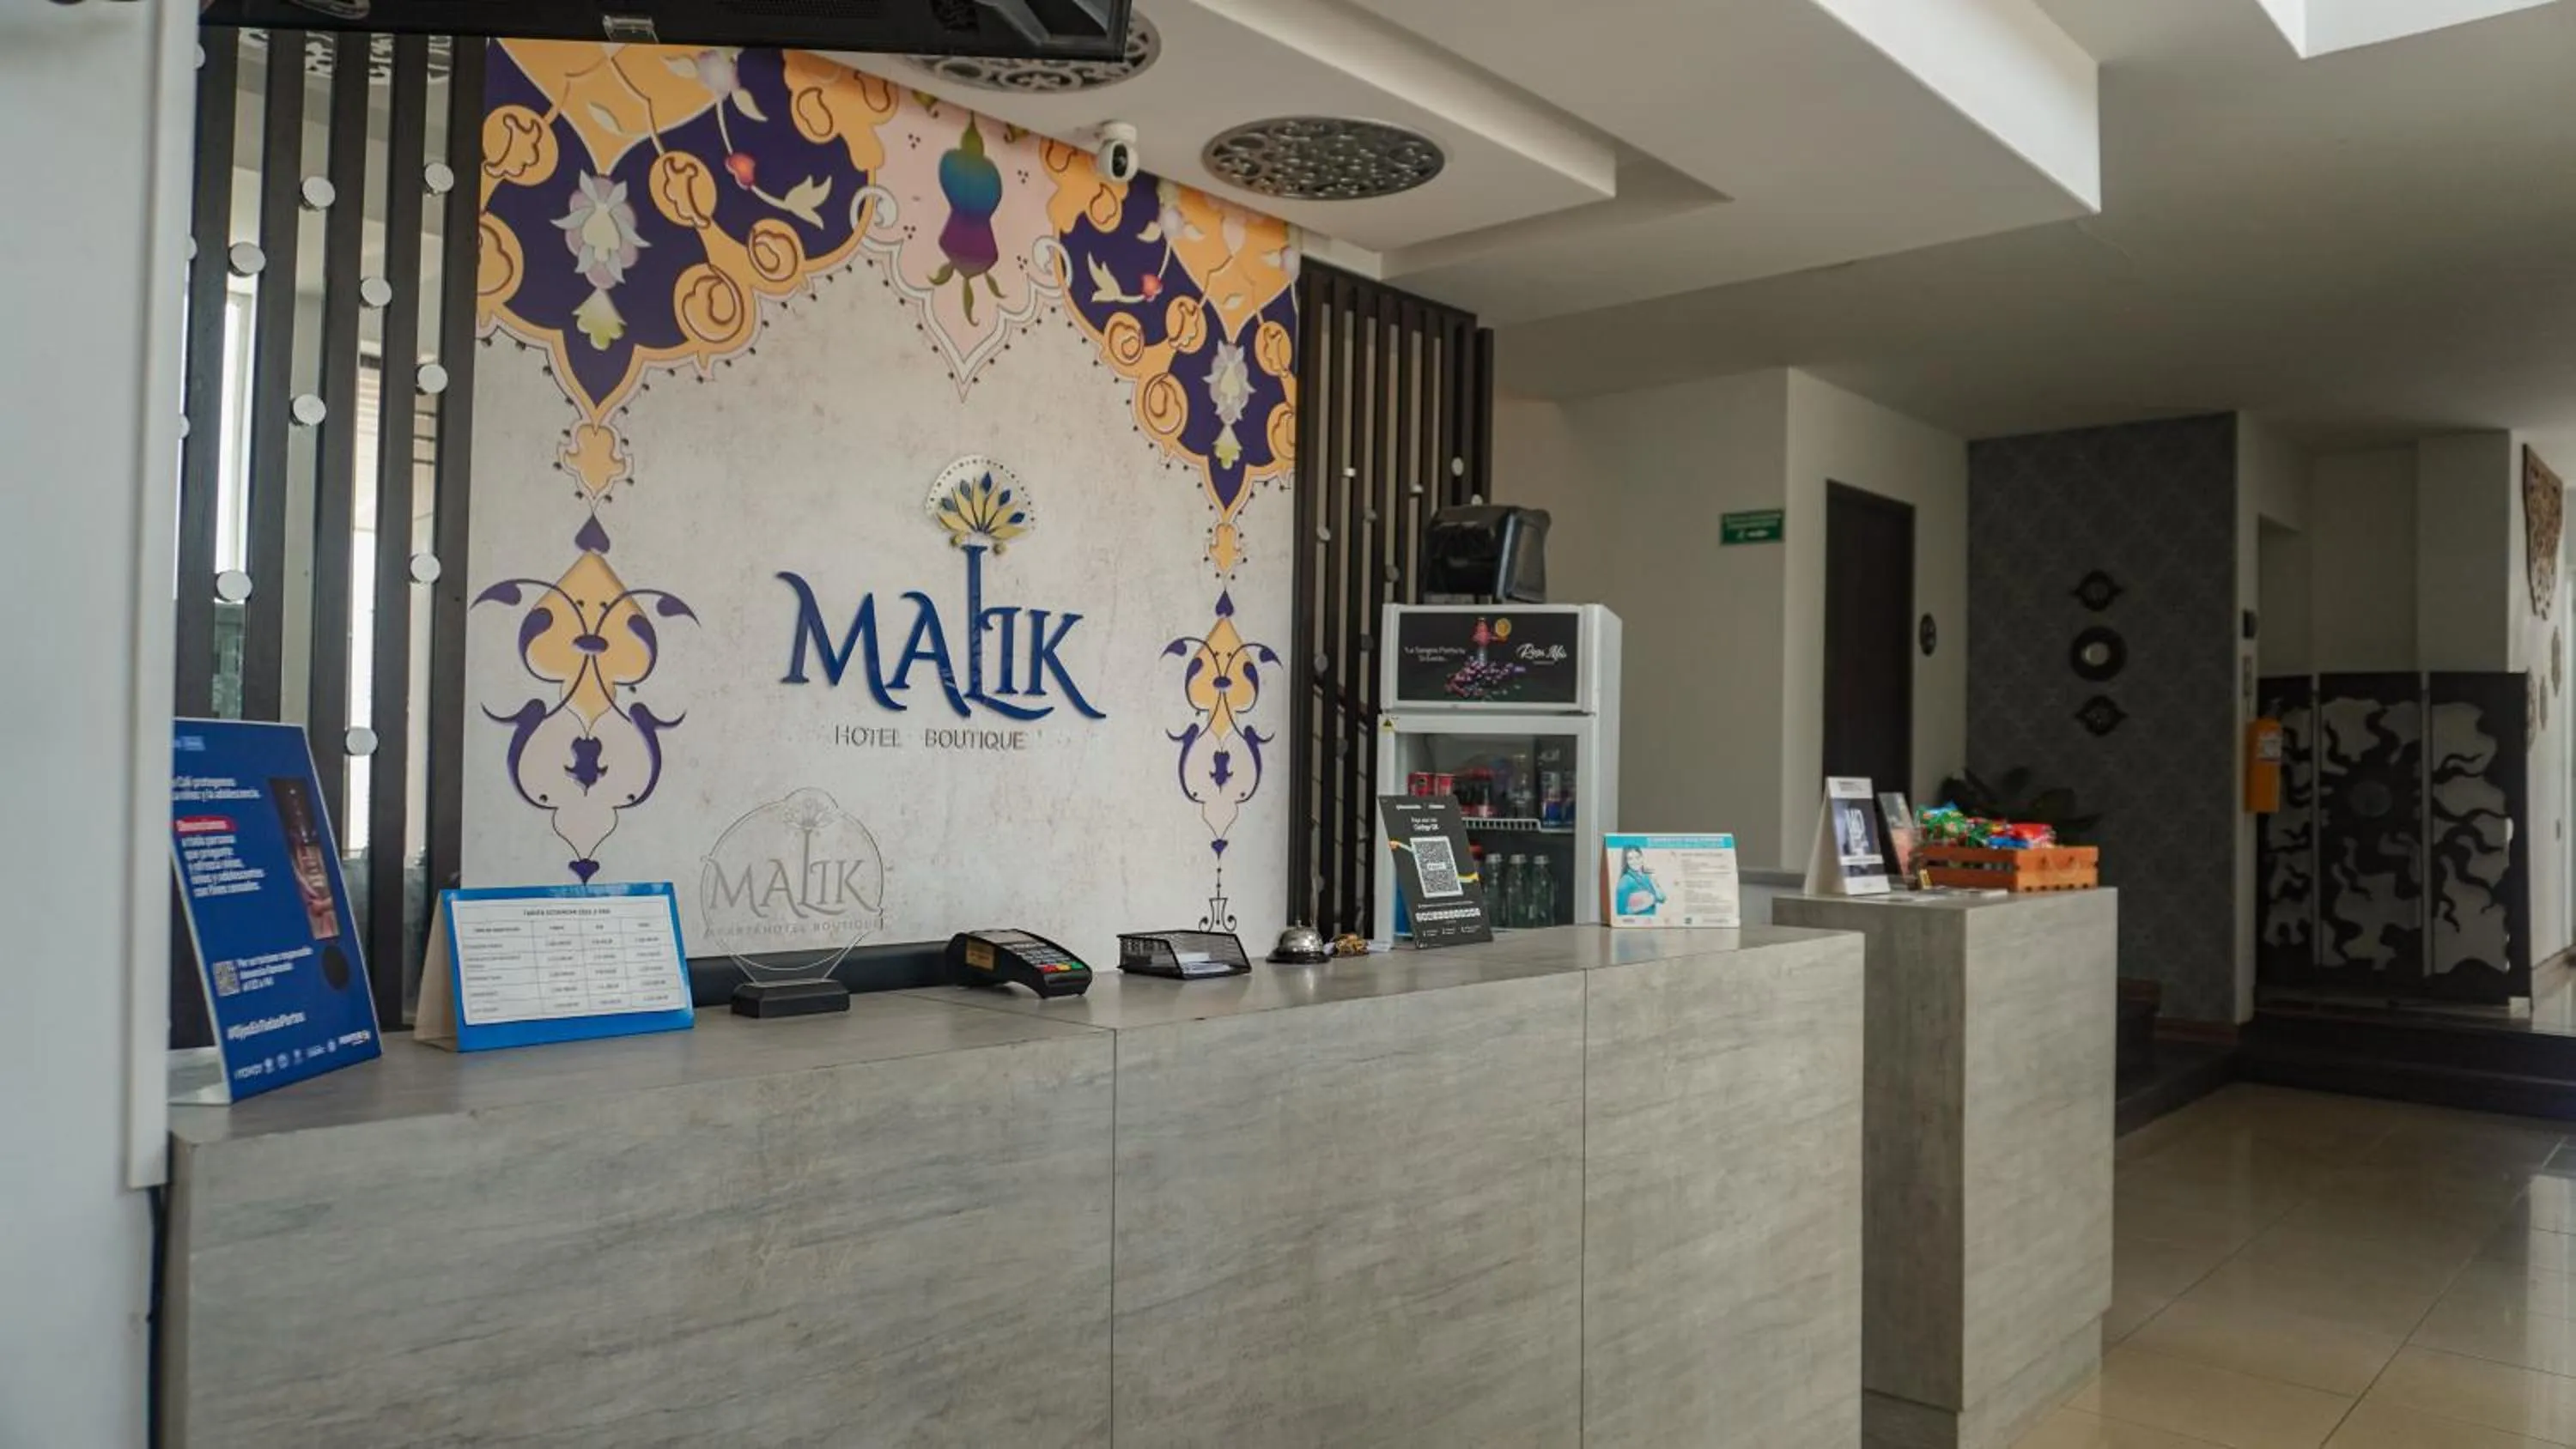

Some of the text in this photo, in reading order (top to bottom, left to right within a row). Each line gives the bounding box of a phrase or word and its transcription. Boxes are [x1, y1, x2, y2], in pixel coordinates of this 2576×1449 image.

[775, 545, 1107, 720] MALIK
[835, 725, 1026, 750] HOTEL BOUTIQUE
[700, 828, 878, 919] MALIK
